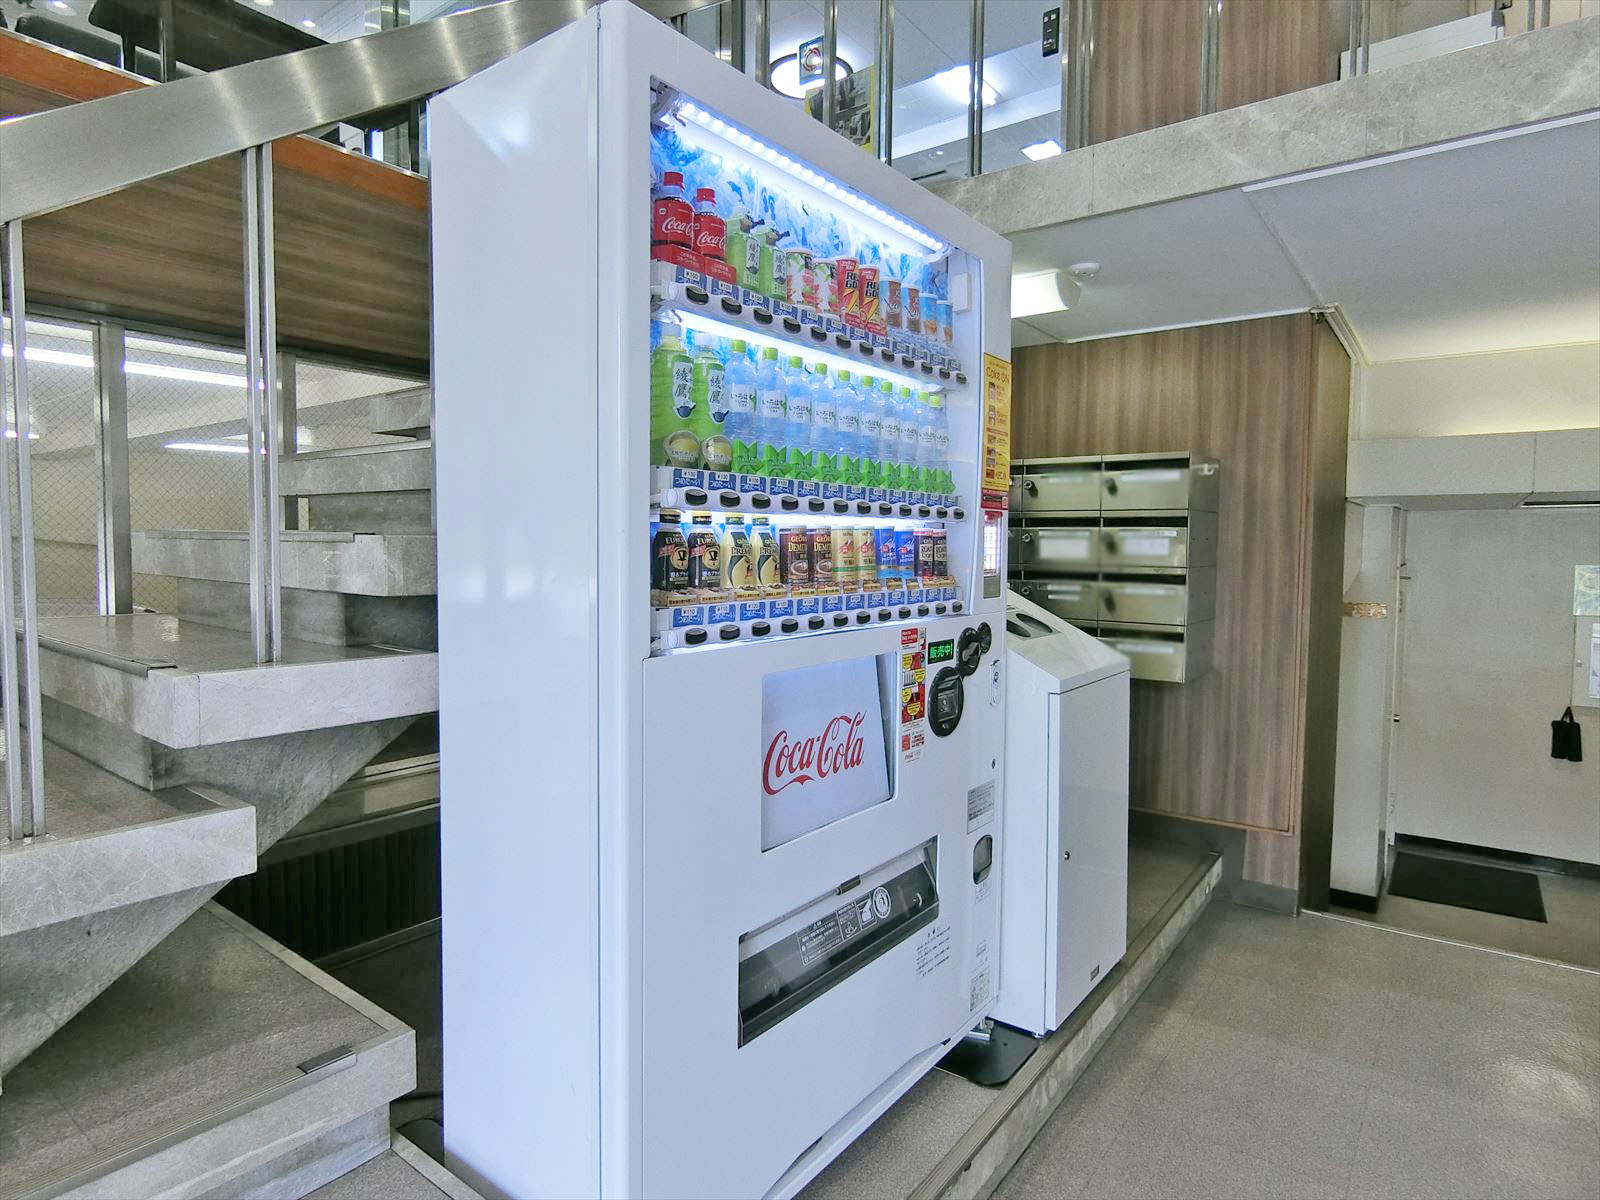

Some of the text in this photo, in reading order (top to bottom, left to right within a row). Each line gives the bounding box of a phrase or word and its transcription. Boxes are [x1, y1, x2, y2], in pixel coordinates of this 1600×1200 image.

[675, 368, 688, 399] 綾鷹
[710, 375, 722, 404] 綾鷹
[930, 643, 950, 659] 販売中
[762, 710, 867, 795] Coca-Cola
